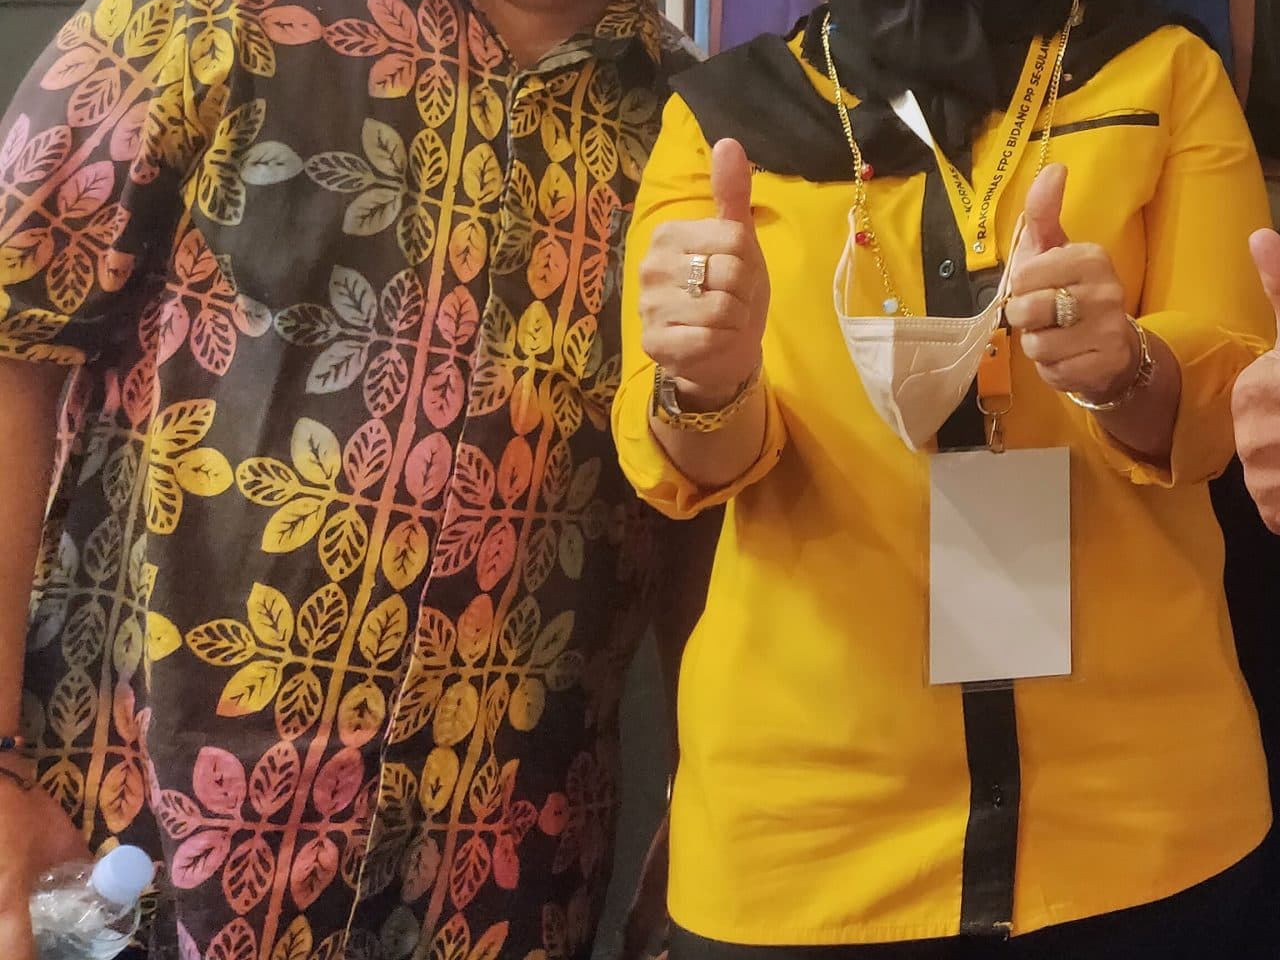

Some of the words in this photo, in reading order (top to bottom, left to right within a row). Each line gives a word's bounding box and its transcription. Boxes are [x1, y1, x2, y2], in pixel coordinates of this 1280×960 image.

[977, 174, 1004, 240] RAKORNAS
[1006, 104, 1031, 147] BIDANG
[1024, 87, 1036, 103] PP
